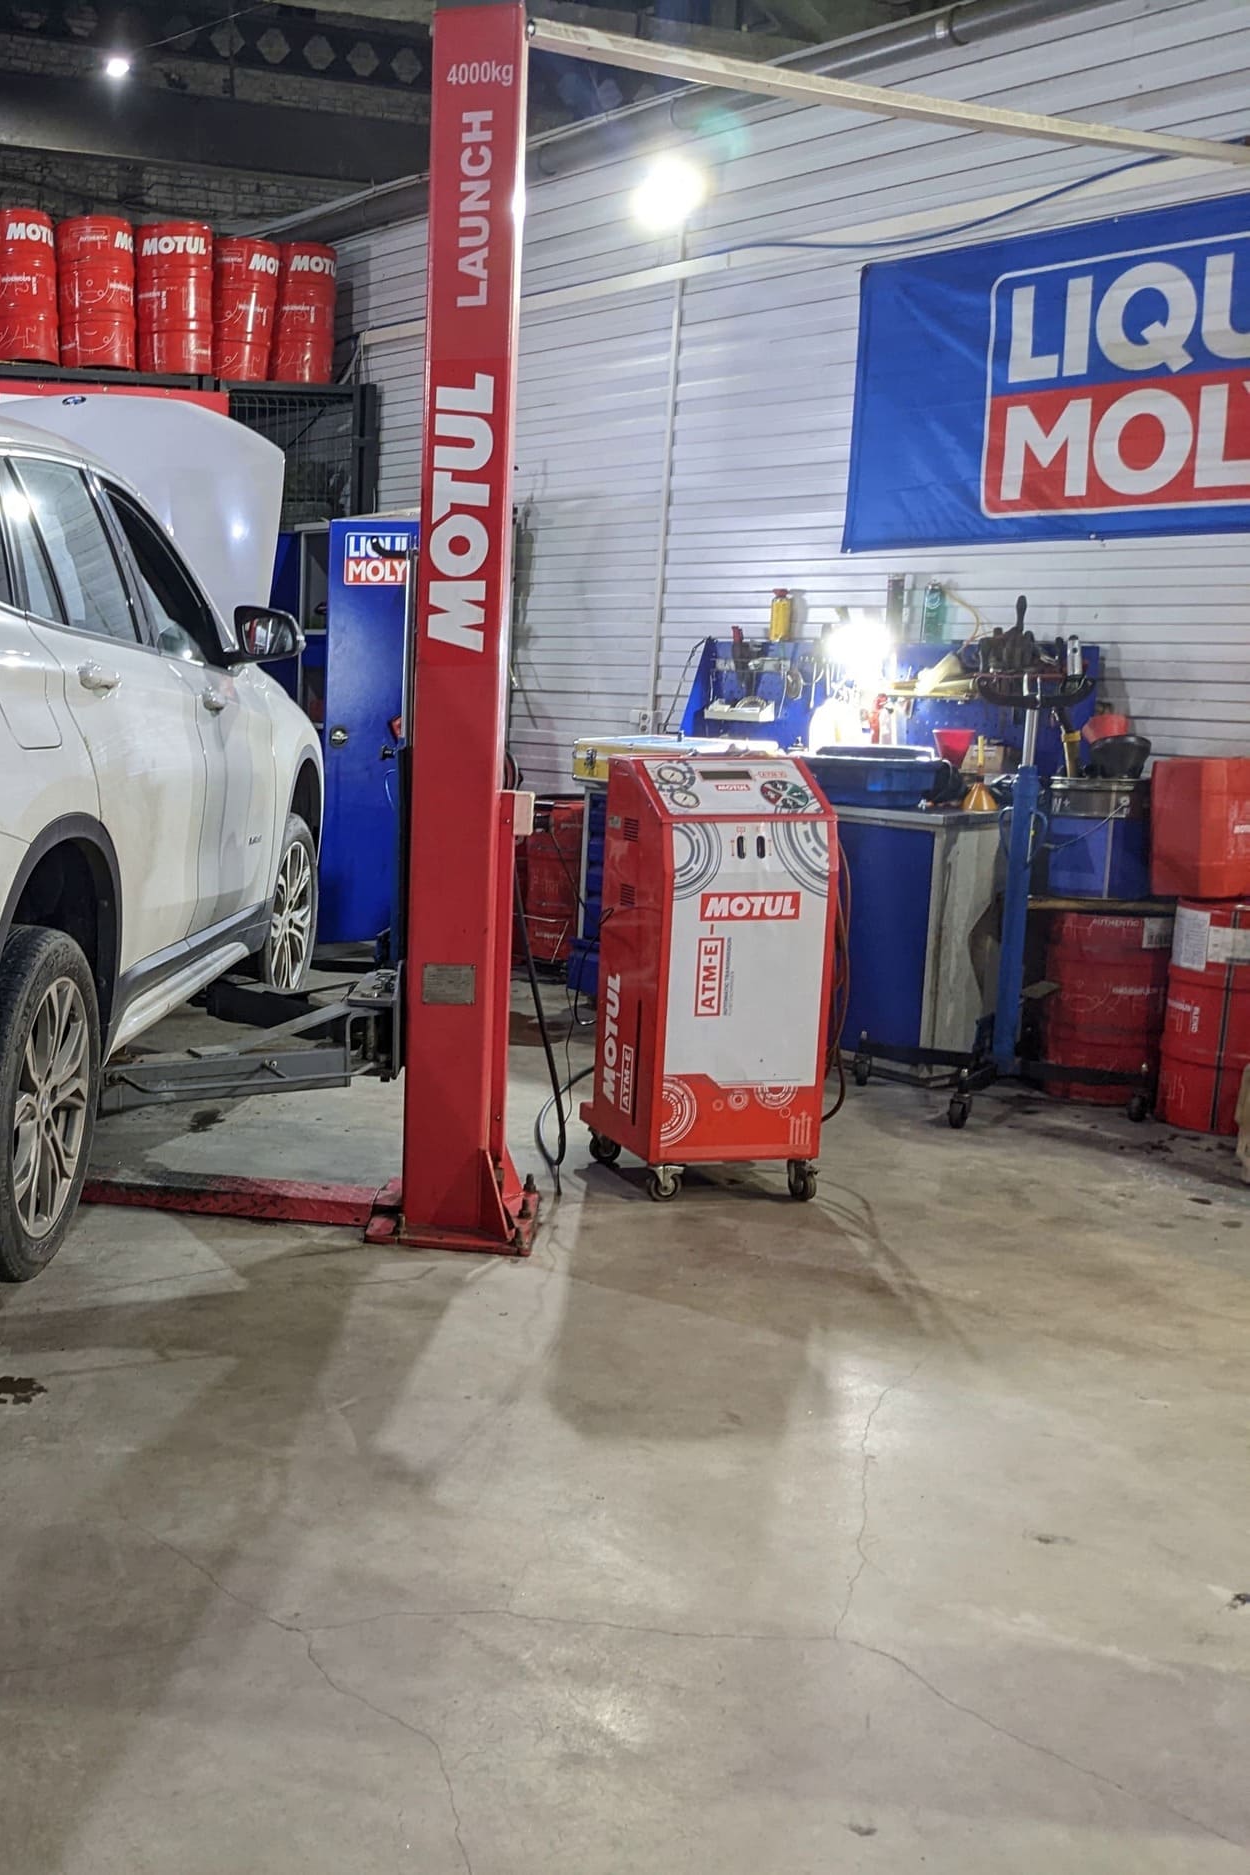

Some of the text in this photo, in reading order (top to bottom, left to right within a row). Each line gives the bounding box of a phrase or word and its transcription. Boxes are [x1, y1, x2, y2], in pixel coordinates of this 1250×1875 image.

[446, 61, 514, 86] 4000kg
[6, 222, 54, 248] MOTU
[457, 110, 493, 308] LAUNCH
[142, 236, 207, 256] MOTUL
[291, 255, 337, 278] MOTU
[1008, 252, 1250, 384] LIQU
[1000, 384, 1250, 500] MOL
[427, 372, 494, 653] MOTUL
[348, 560, 407, 582] MOLY
[704, 895, 796, 917] MOTUL
[701, 944, 718, 1010] ATM-E
[603, 973, 621, 1105] MOTUL
[622, 1050, 632, 1109] ATM-E
